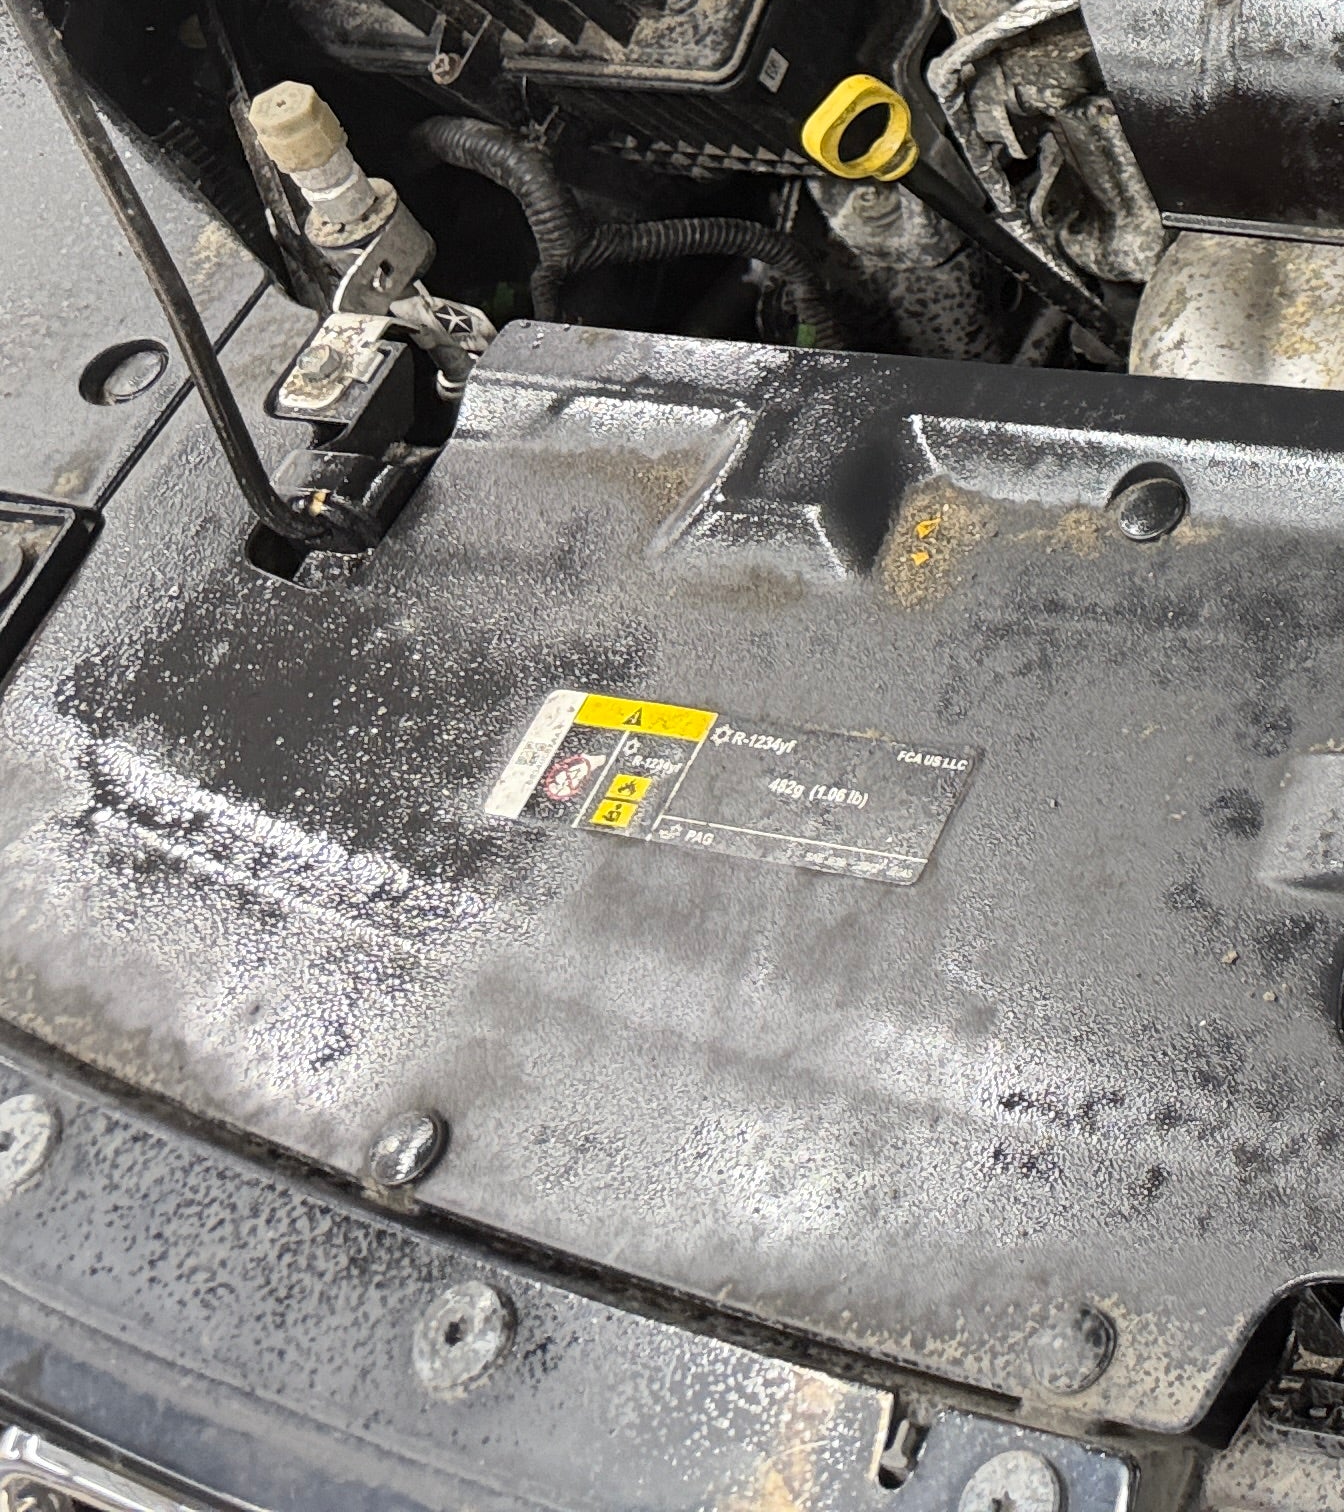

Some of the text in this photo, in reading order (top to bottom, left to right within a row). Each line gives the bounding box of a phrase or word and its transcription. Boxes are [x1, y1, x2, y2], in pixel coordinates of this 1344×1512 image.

[731, 732, 797, 755] R-1234yf
[897, 751, 968, 771] FCA US LLC
[685, 829, 715, 845] PAG
